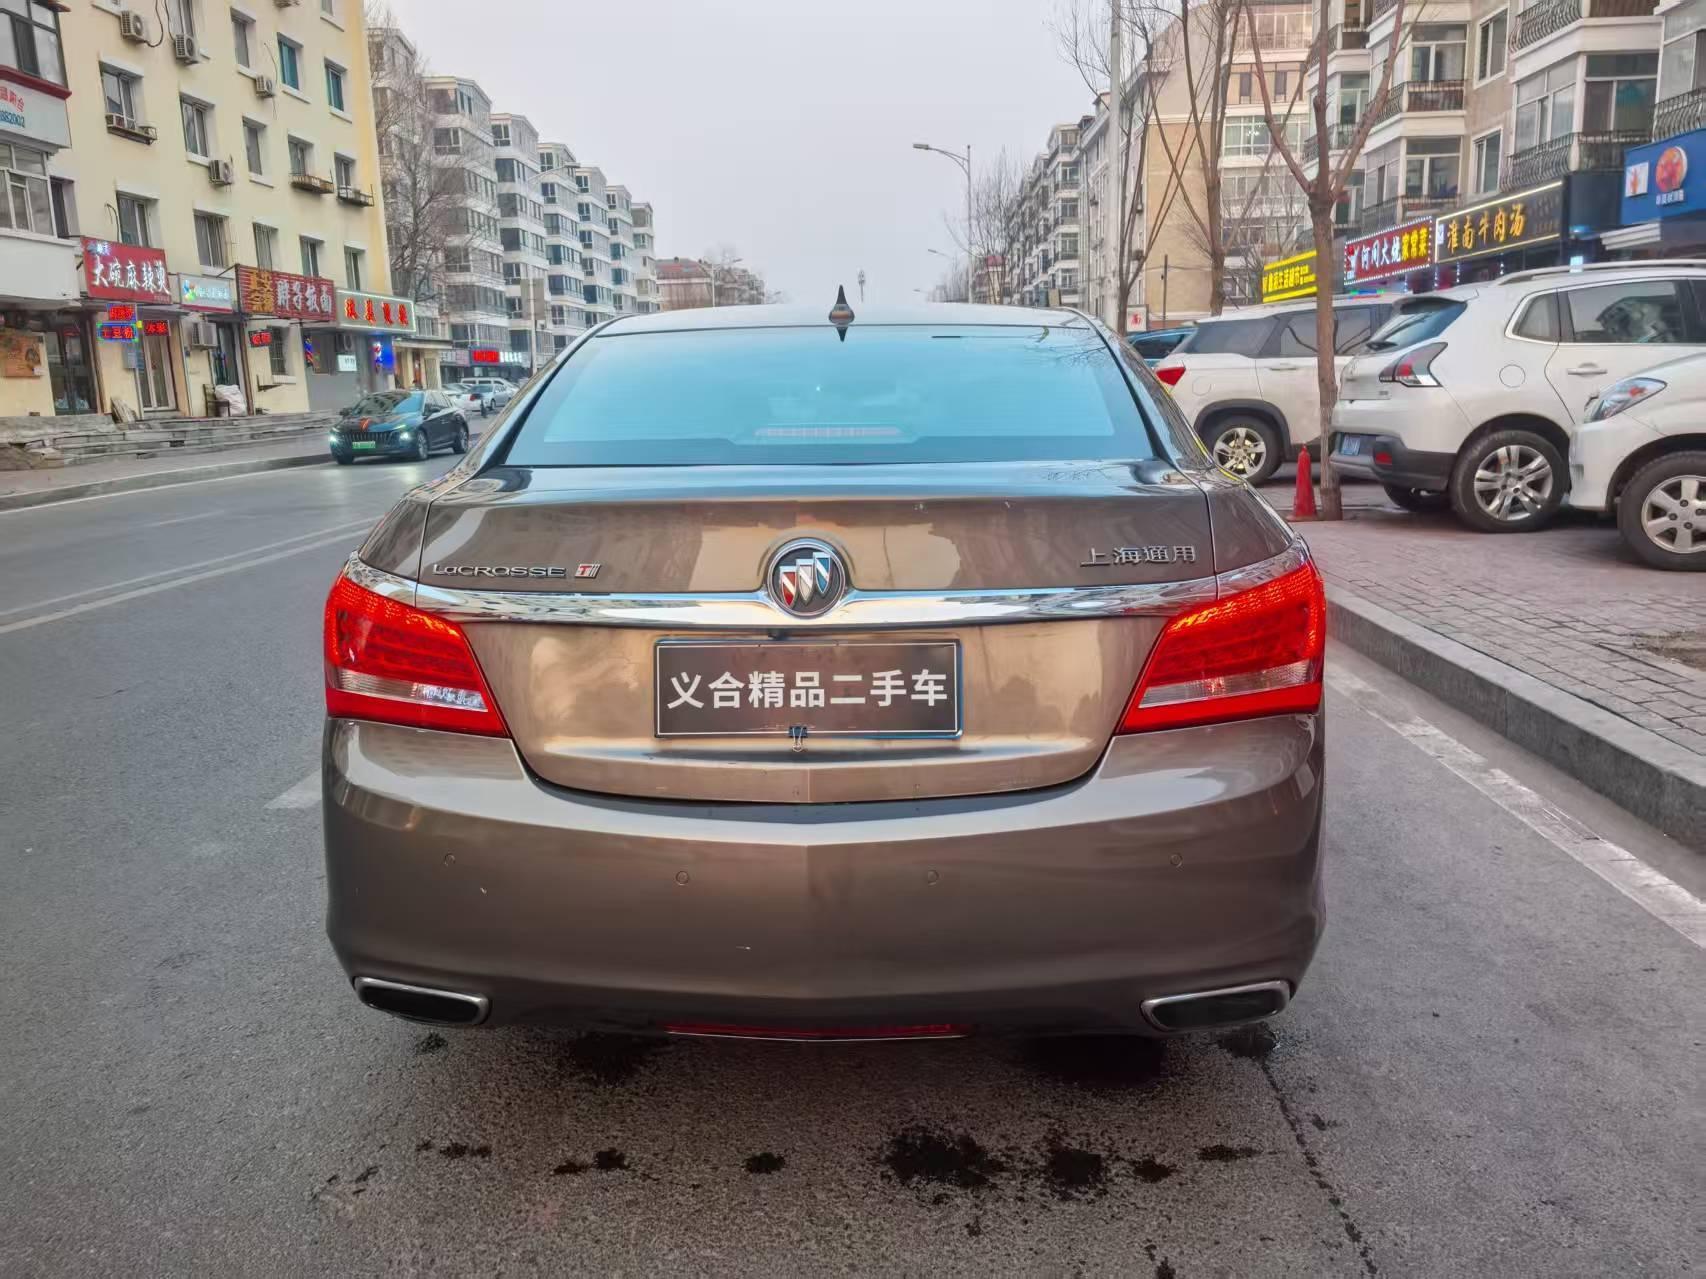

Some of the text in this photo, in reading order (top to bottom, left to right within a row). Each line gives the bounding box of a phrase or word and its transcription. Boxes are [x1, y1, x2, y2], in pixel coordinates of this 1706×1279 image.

[1401, 227, 1430, 261] 家常菜
[1447, 203, 1526, 254] 淮南牛肉汤
[91, 254, 171, 296] 大碗麻辣烫
[1080, 545, 1196, 567] 上海通用
[667, 669, 948, 709] 义合精品二手车
